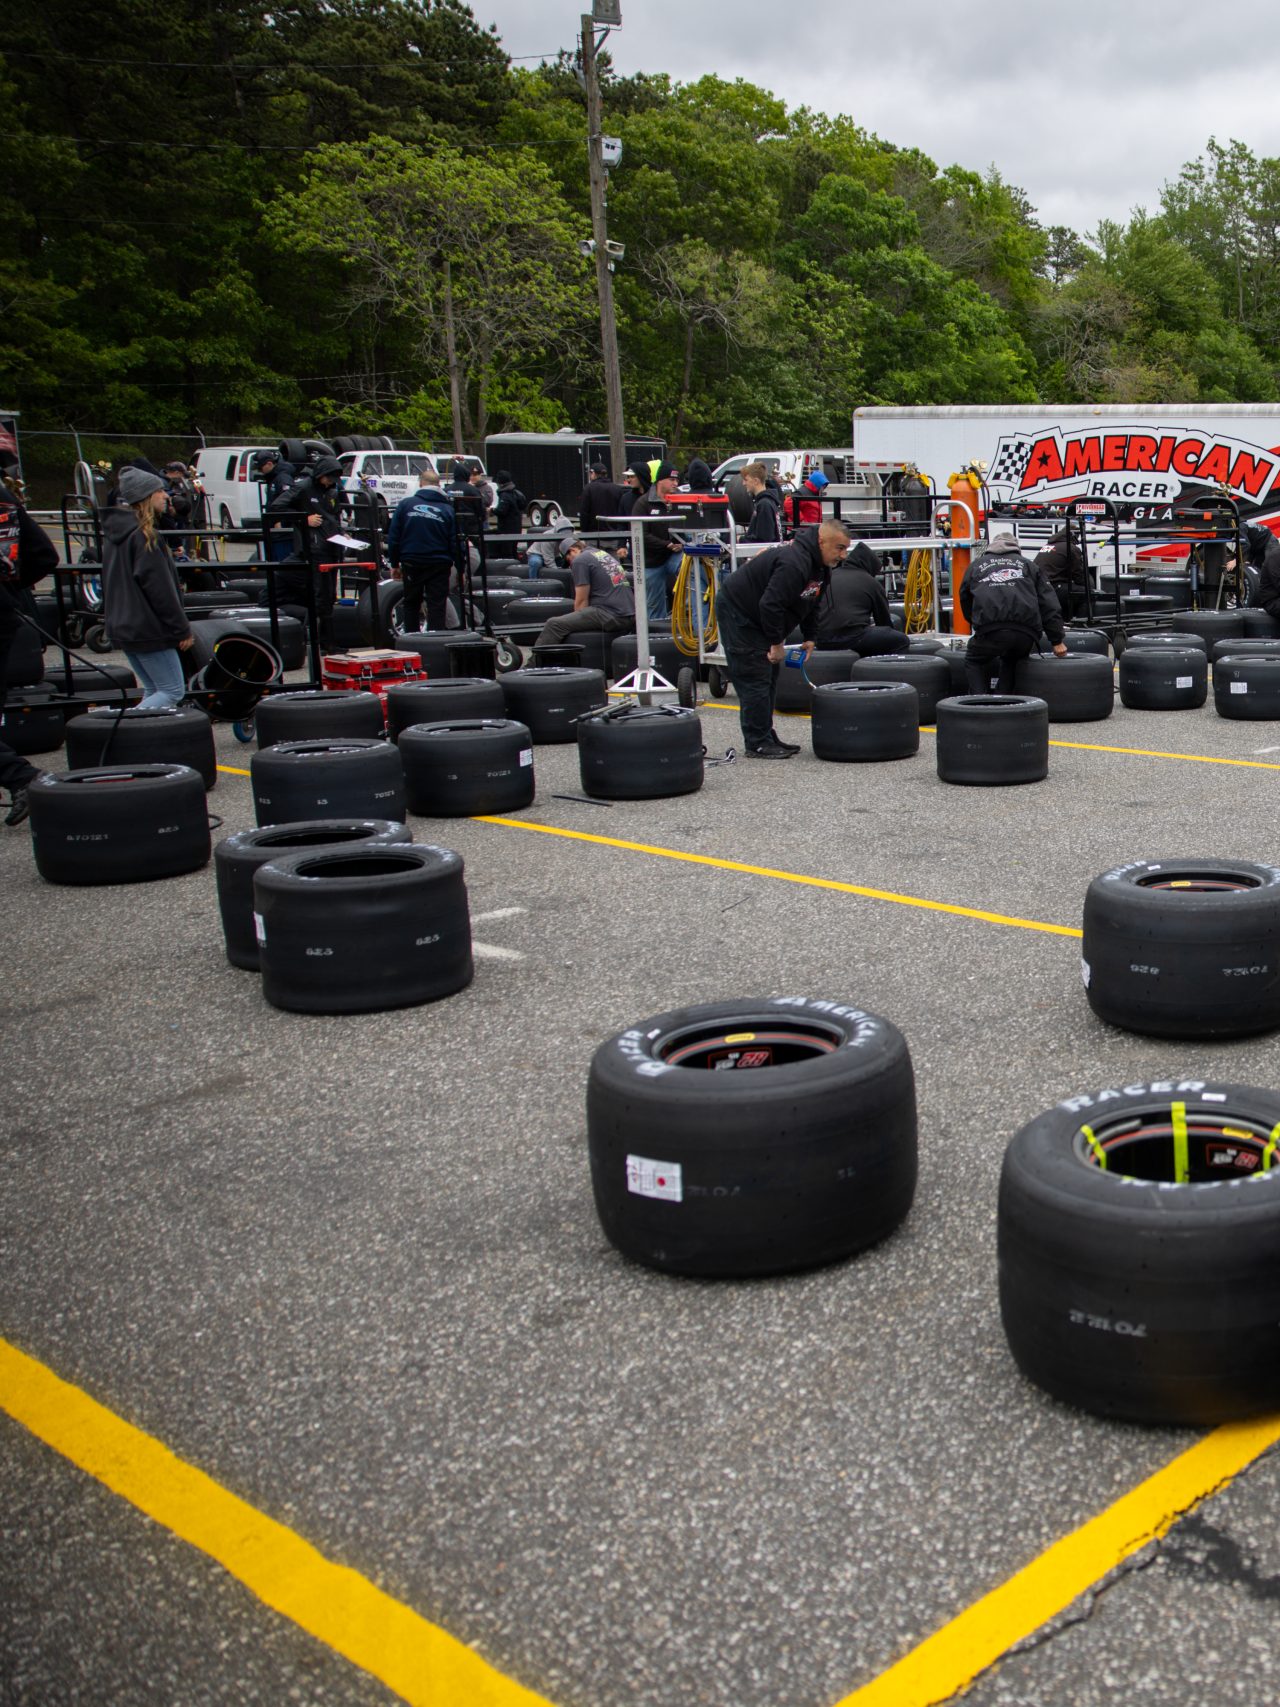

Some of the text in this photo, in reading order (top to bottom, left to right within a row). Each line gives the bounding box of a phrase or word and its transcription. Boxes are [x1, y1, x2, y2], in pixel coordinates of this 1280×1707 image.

[1019, 434, 1274, 496] AMERICAN
[1091, 481, 1168, 498] RACER
[1058, 1080, 1207, 1114] RACER
